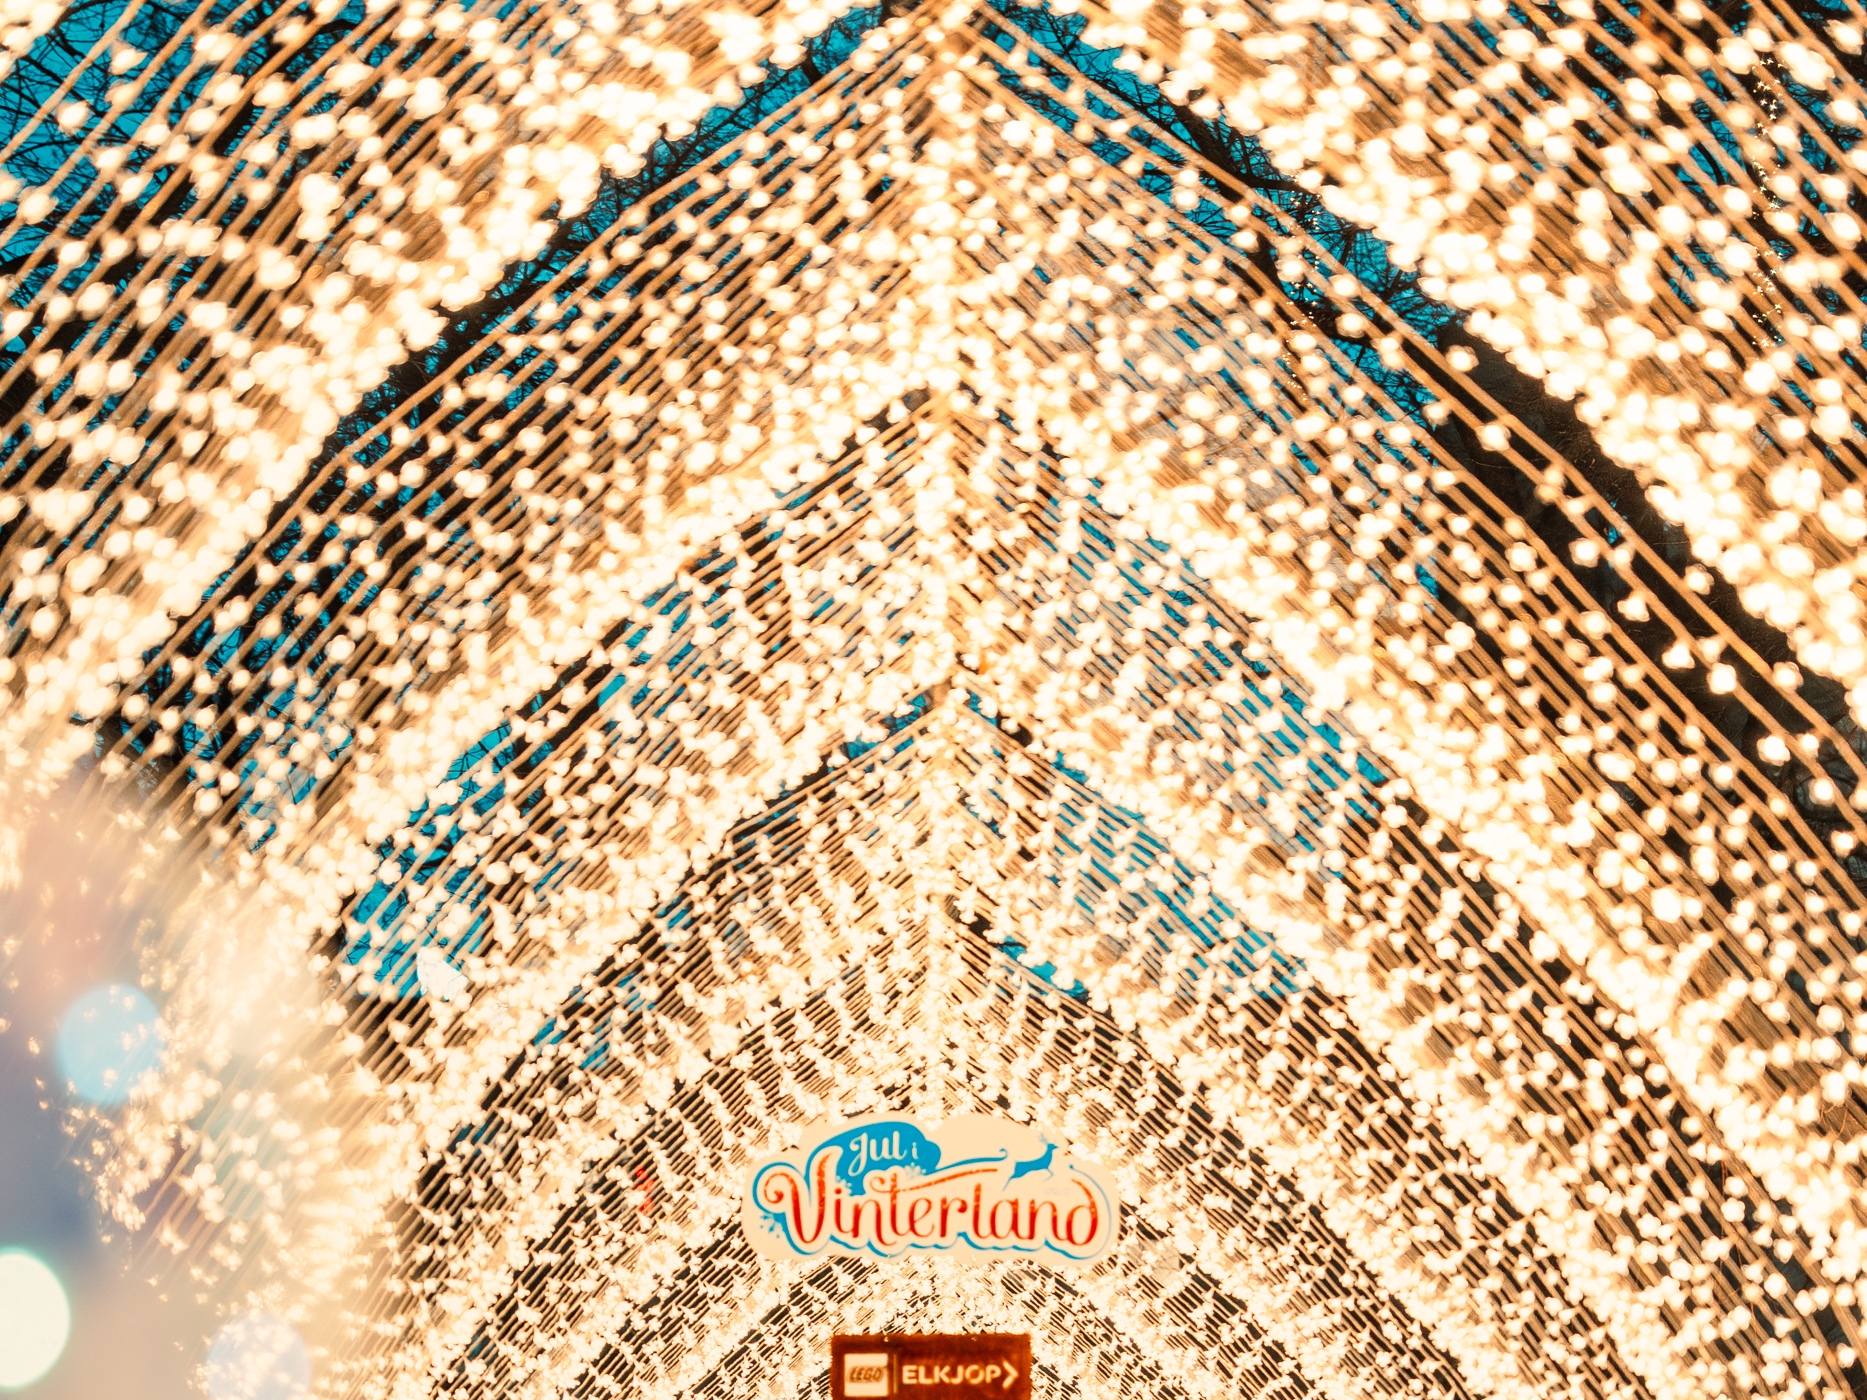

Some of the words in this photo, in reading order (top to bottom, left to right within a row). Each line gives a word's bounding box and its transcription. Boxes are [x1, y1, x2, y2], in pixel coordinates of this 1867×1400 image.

[847, 1130, 907, 1176] Jul
[911, 1141, 919, 1160] i
[763, 1150, 1099, 1247] Vinterland
[849, 1366, 884, 1383] LEGO
